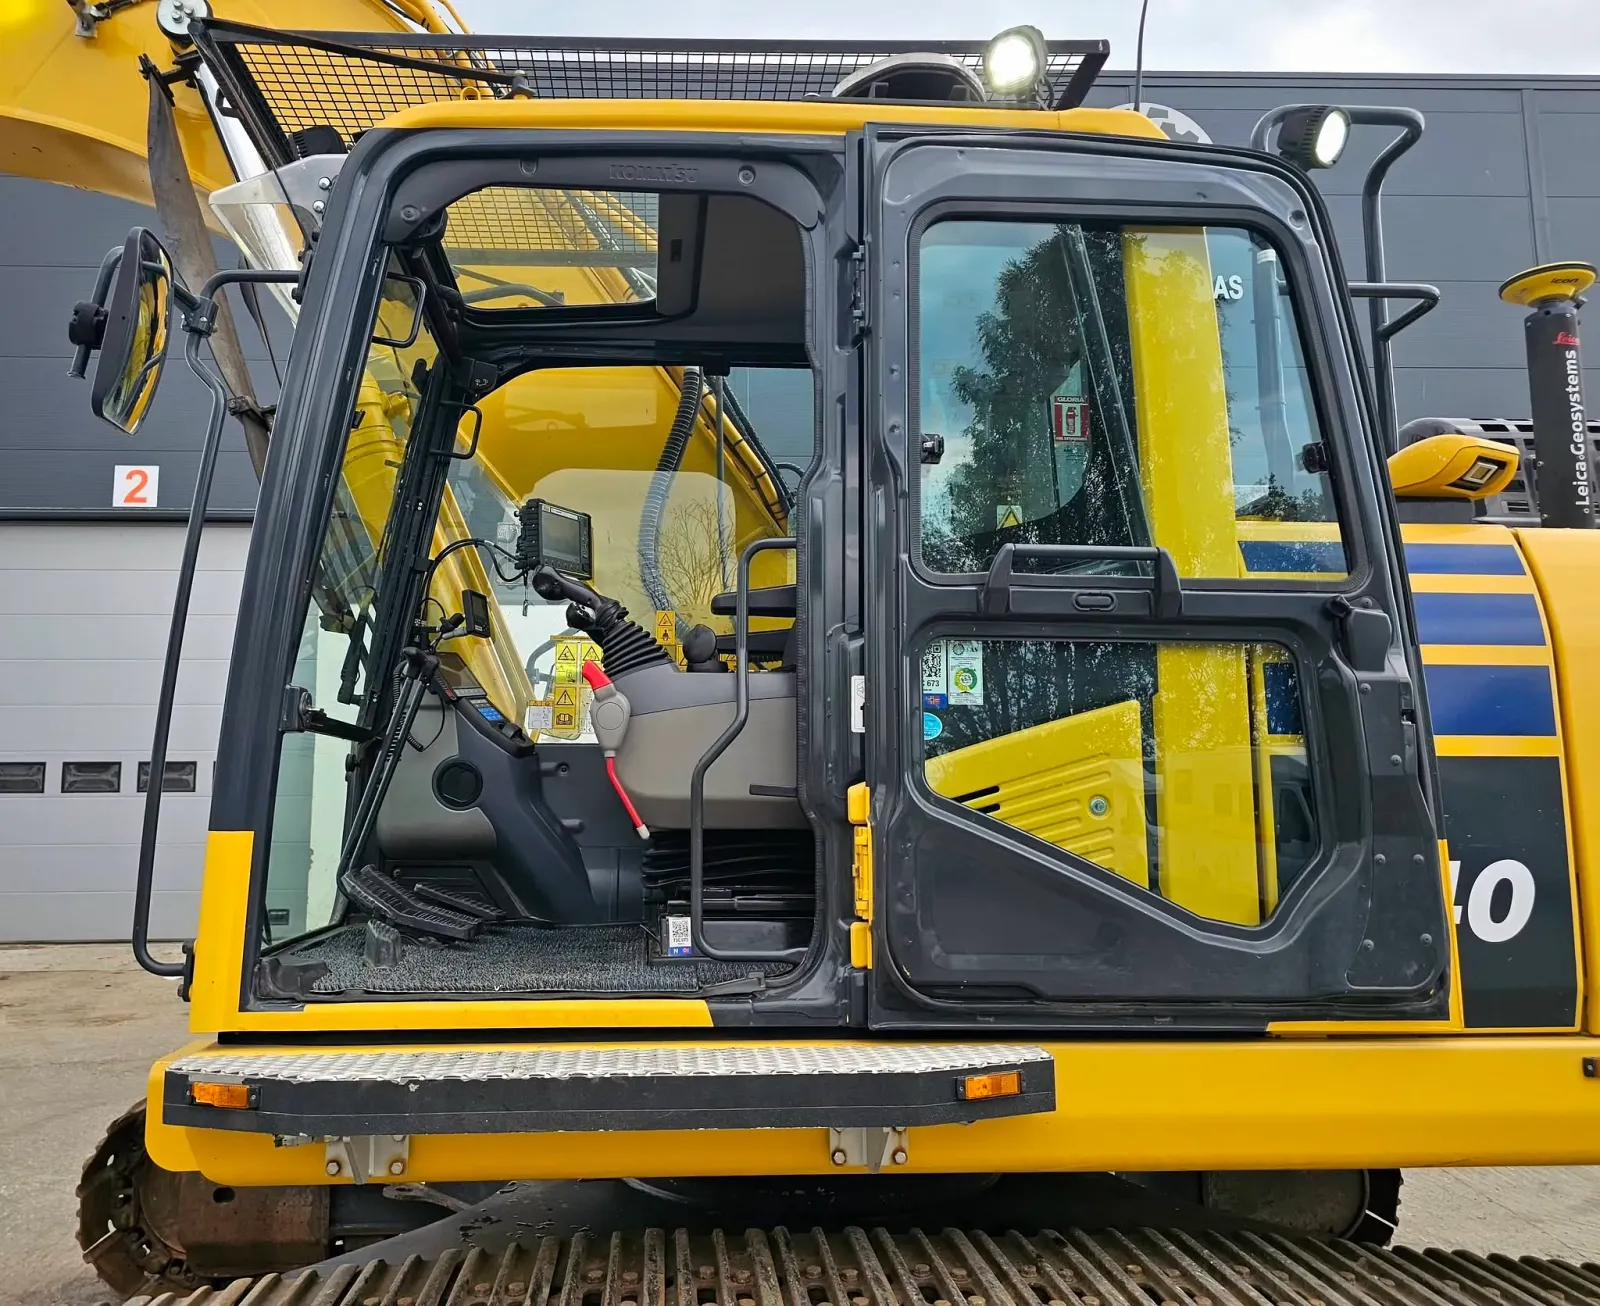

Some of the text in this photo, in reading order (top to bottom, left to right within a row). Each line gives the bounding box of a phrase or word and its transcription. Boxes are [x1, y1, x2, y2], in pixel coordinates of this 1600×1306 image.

[1214, 274, 1244, 300] AS
[1565, 349, 1590, 506] Leica Geosystems
[123, 469, 149, 504] 2
[926, 679, 940, 687] 673
